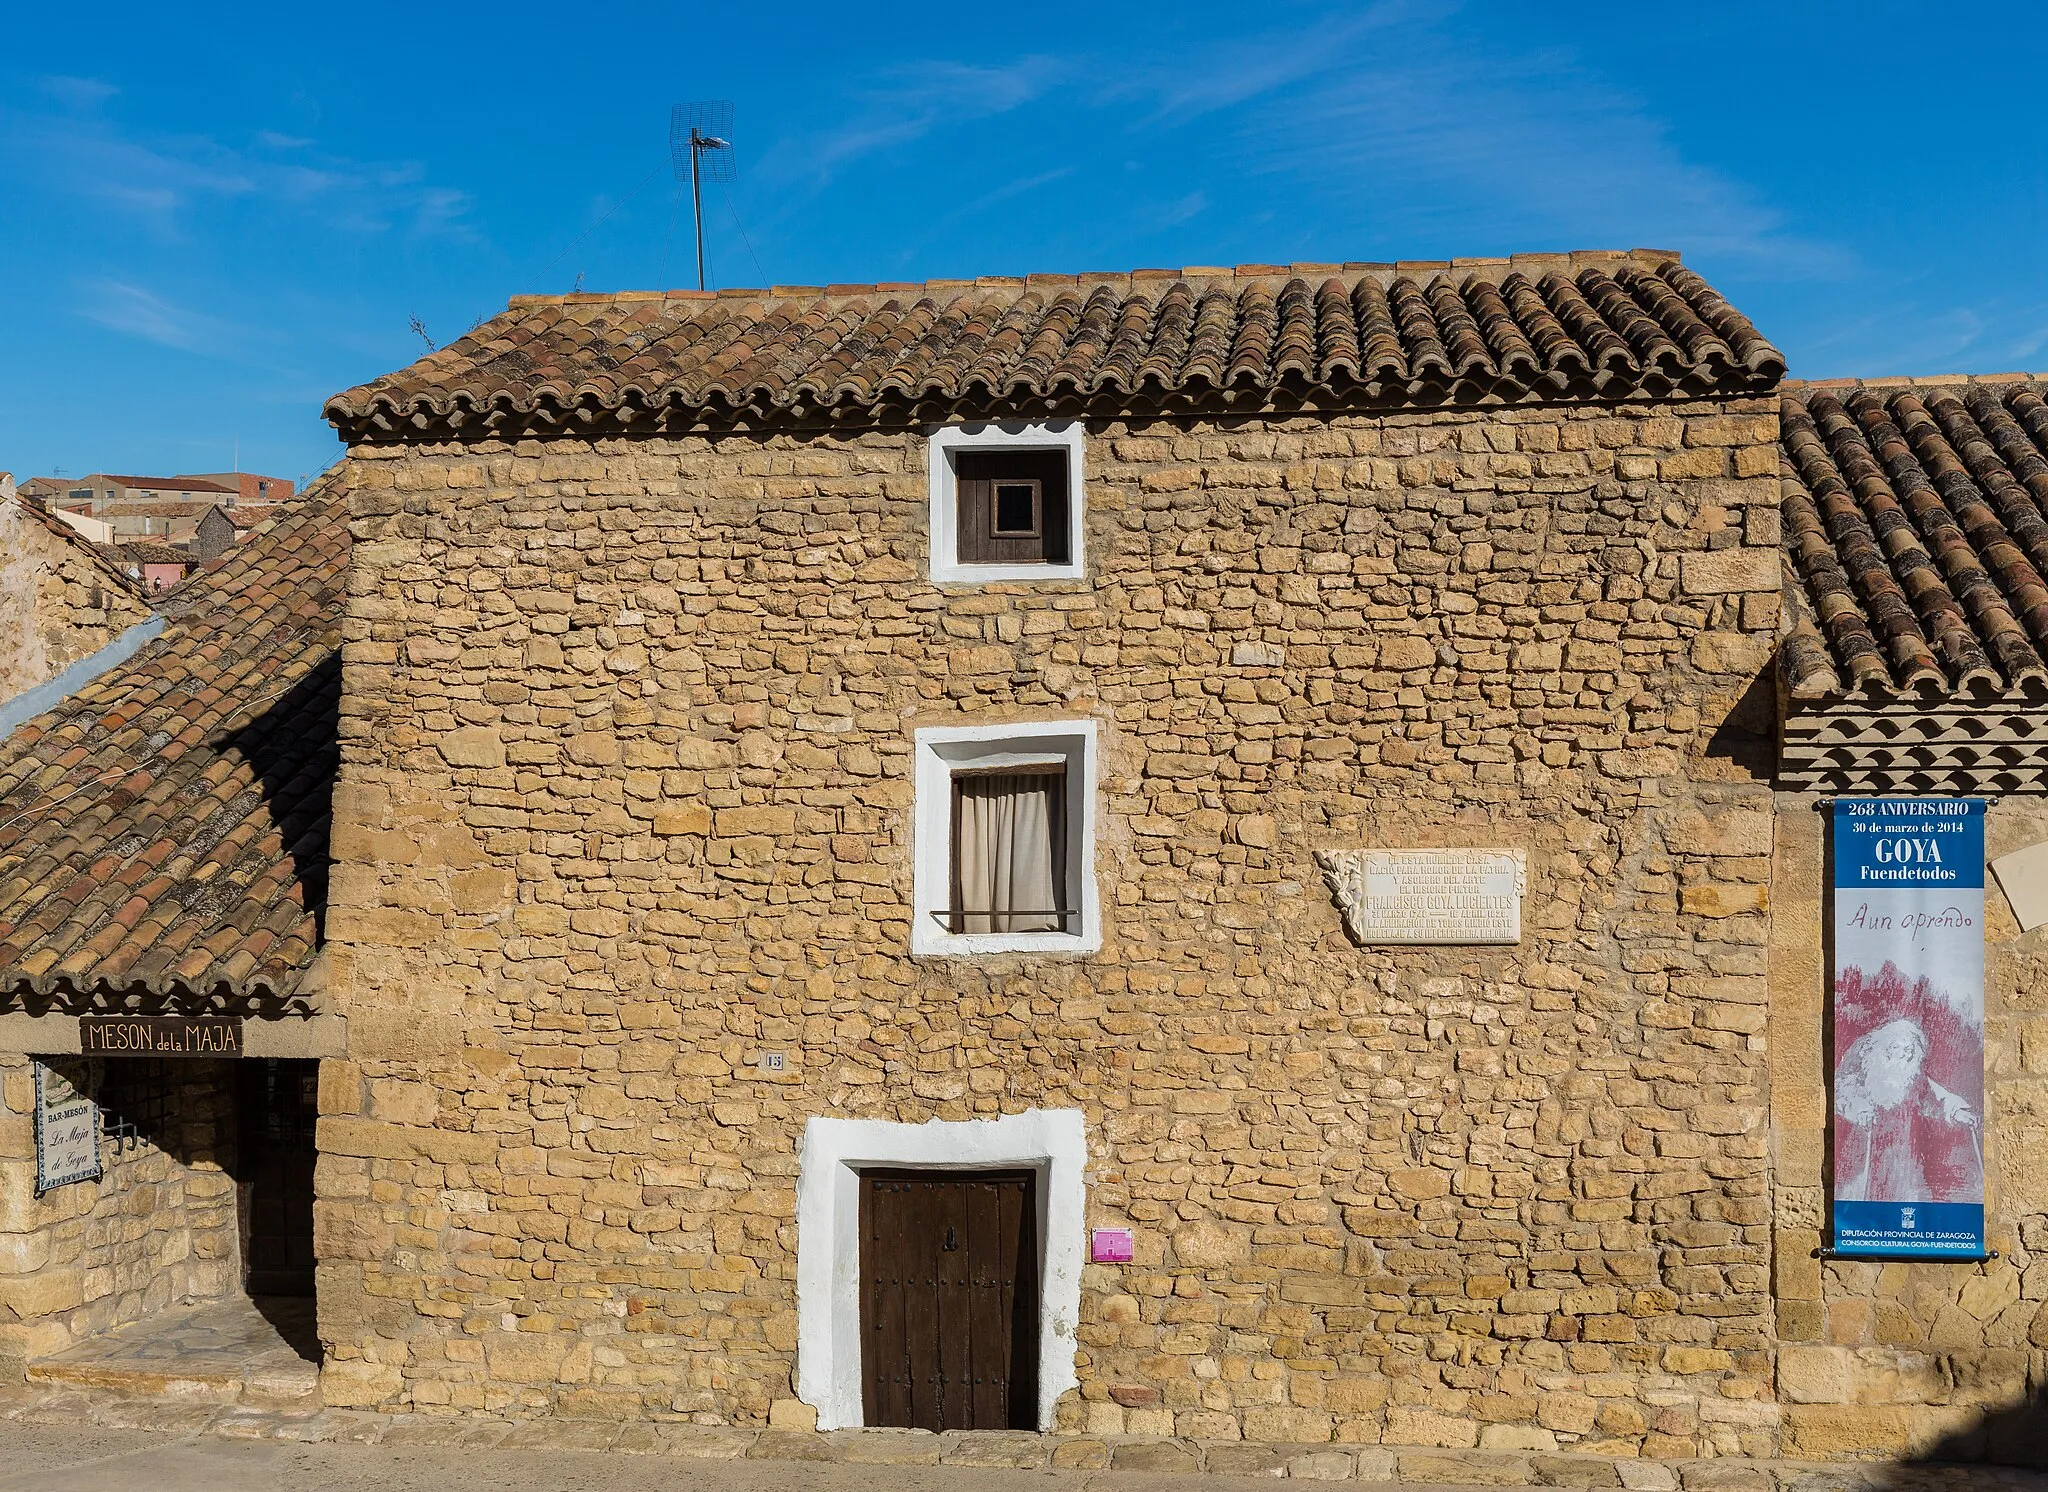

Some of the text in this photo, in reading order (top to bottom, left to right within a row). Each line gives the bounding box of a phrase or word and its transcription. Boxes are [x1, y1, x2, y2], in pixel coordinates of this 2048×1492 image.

[1877, 802, 1969, 816] ANIVERSARIO
[1852, 822, 1964, 833] 30 de marzo de 2014
[1875, 838, 1942, 863] GOYA
[1388, 855, 1490, 864] EN ESTA HUMILDE CASA
[1369, 864, 1509, 874] NACIÓ PARA HONOR DE LA PATRIA
[1860, 865, 1956, 880] Fuendetodos
[1393, 876, 1486, 884] Y ASOMBRO DEL ARTE
[1399, 885, 1480, 894] EL INSIGNE PINTOR
[1366, 896, 1513, 909] FRANCISCO GOYA LUCIENTES
[1382, 910, 1408, 918] MARZO
[1461, 910, 1486, 918] ABRIL
[1847, 902, 1892, 929] Aun
[1367, 919, 1378, 928] LA
[1379, 918, 1424, 928] ADMIRACIÓN
[1426, 919, 1437, 928] DE
[1438, 919, 1463, 928] TODOS
[1493, 919, 1513, 928] ESTE
[1366, 929, 1406, 938] HOMENAJE
[1407, 929, 1413, 938] A
[1414, 929, 1423, 938] SU
[89, 1024, 153, 1050] MESON
[185, 1025, 237, 1052] MAJA
[48, 1104, 89, 1124] BAR-MESÓN
[49, 1125, 89, 1147] La Maja
[51, 1151, 88, 1171] de Goya
[1841, 1229, 1976, 1240] DIPUTACIÓN PROVINCIAL DE ZARAGOZA
[1841, 1239, 1976, 1249] CONSORCIO CULTURAL GOYA-FUENDETODOS
